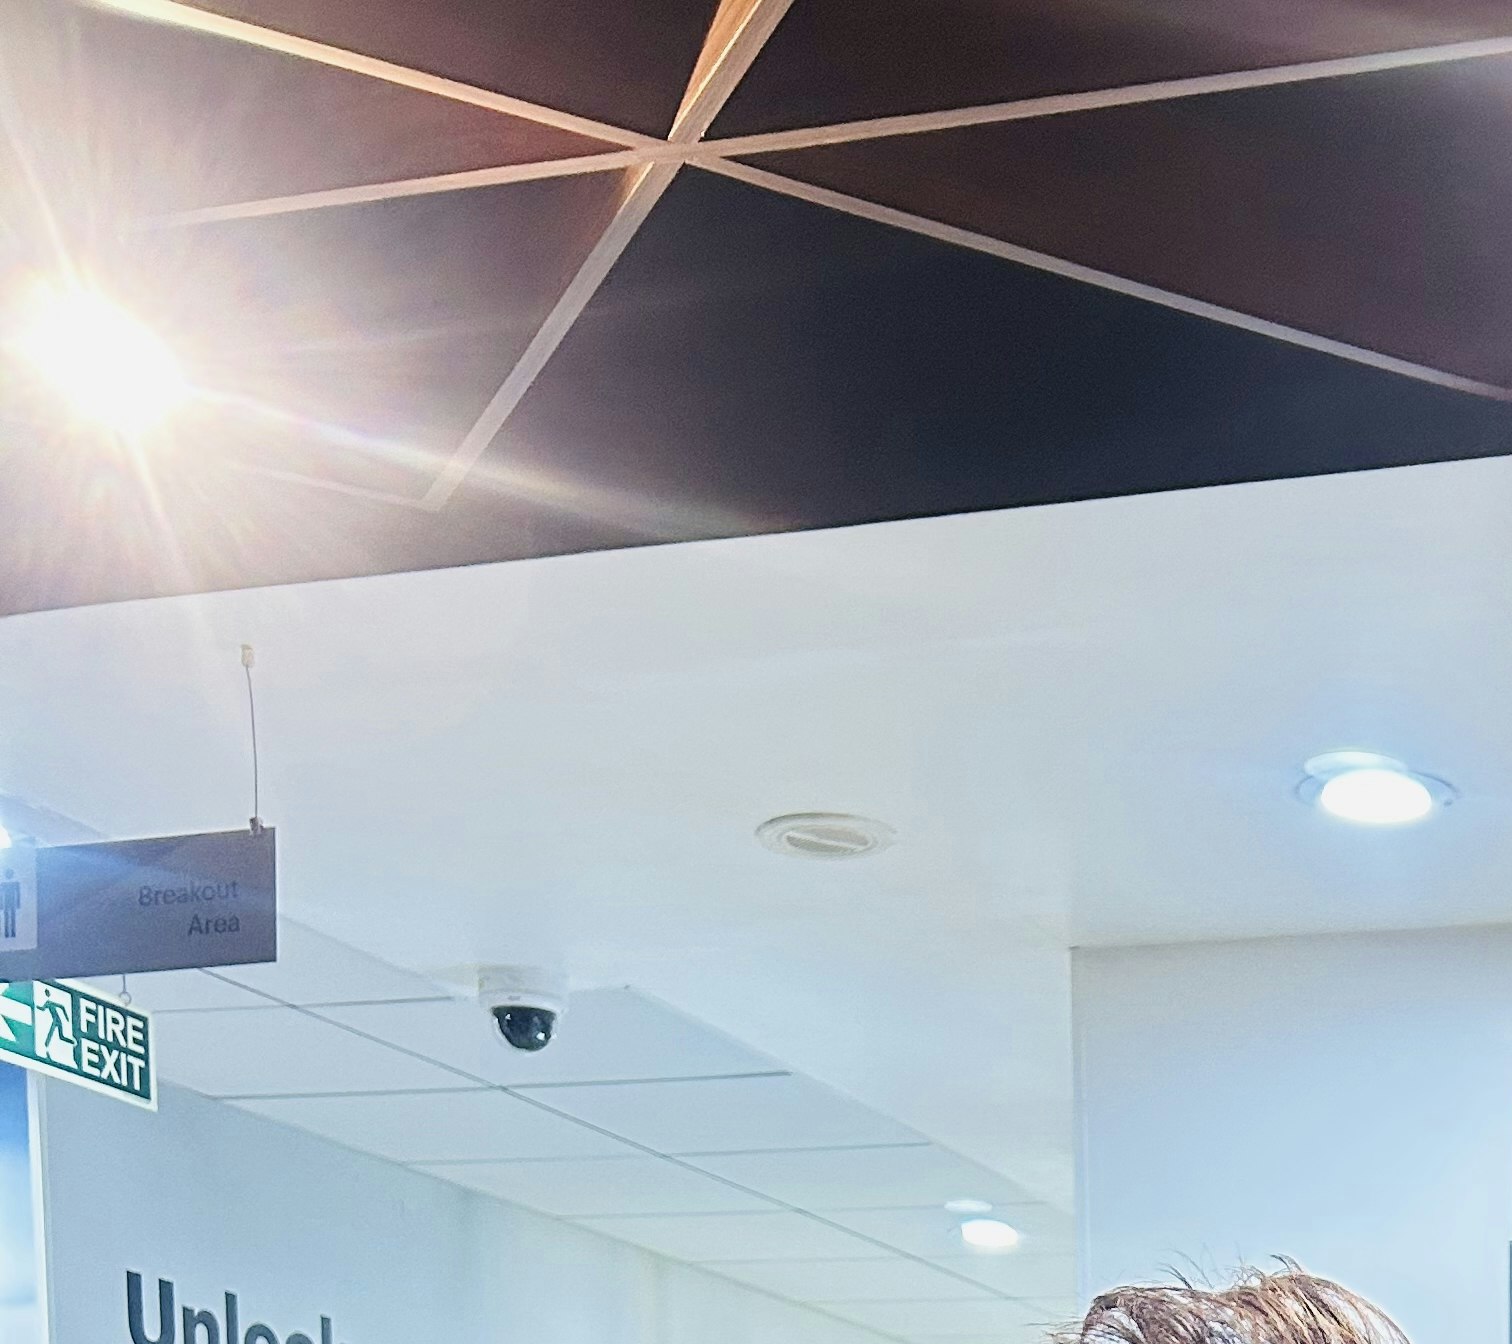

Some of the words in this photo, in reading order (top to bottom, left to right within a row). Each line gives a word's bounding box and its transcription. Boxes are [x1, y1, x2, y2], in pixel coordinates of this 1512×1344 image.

[138, 880, 239, 906] Breakout
[187, 914, 240, 937] Area
[79, 997, 146, 1054] FIRE
[81, 1037, 146, 1091] EXIT
